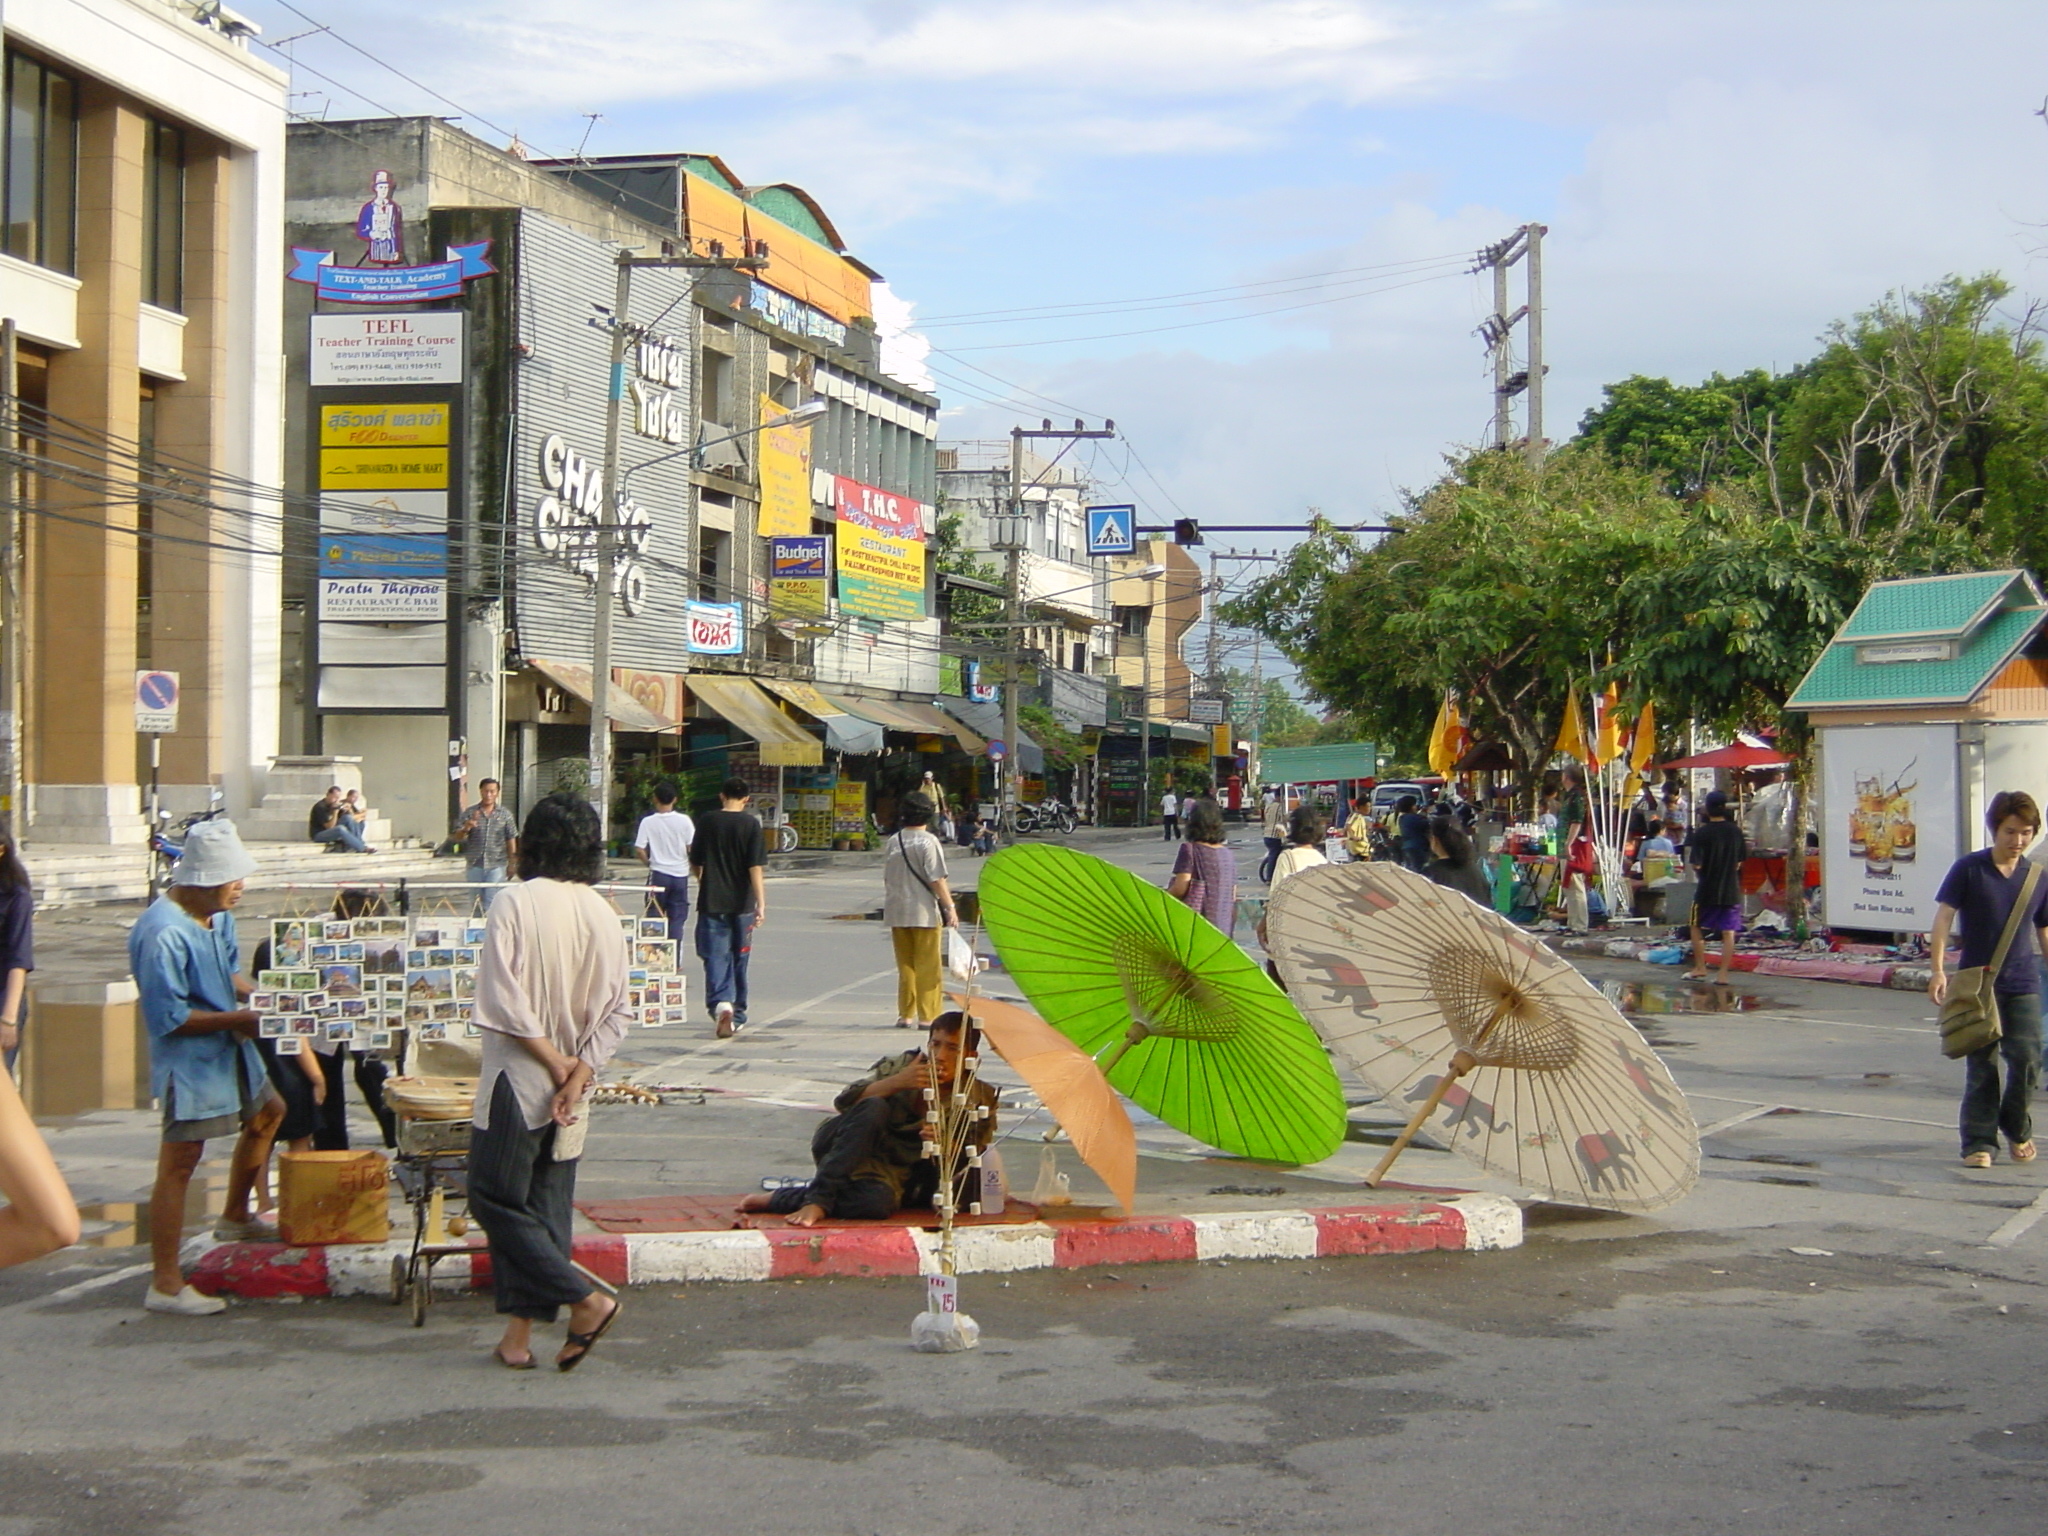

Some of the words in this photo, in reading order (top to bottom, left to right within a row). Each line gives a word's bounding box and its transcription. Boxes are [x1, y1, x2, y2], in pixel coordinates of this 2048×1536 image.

[334, 274, 402, 284] TEXT-AND-TALK
[407, 272, 447, 284] Academy
[351, 292, 379, 302] English
[380, 291, 429, 301] Conversation
[362, 319, 414, 334] TEFL
[318, 337, 362, 347] Teacher
[366, 336, 414, 347] Training
[416, 335, 456, 346] Course
[862, 489, 901, 524] T.H.C.
[775, 544, 824, 562] Budget
[860, 537, 907, 558] RESTAURANT
[327, 582, 373, 594] Pratu
[327, 598, 399, 606] RESTAURANT
[413, 598, 438, 606] BAR
[942, 1293, 955, 1313] 15
